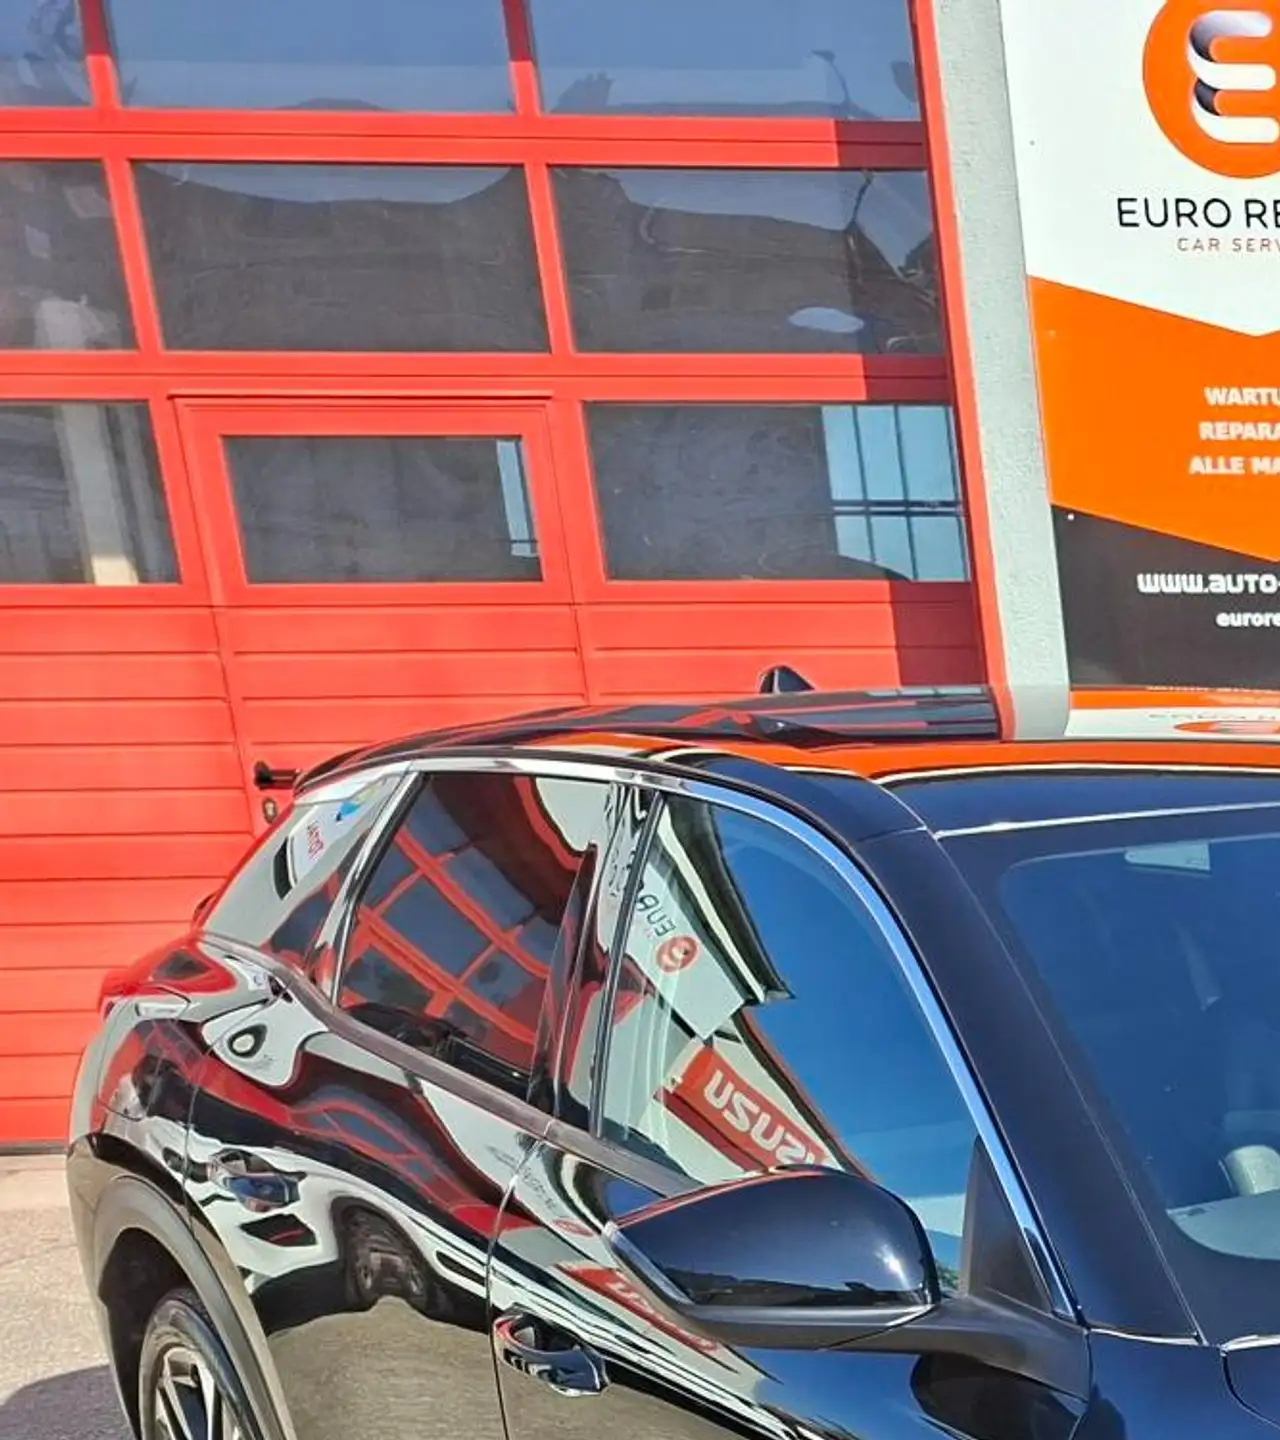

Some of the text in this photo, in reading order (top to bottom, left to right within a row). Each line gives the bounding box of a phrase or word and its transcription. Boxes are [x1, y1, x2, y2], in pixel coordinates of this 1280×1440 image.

[1116, 197, 1232, 229] EURO
[1176, 238, 1221, 252] CAR
[1189, 456, 1244, 475] ALLE
